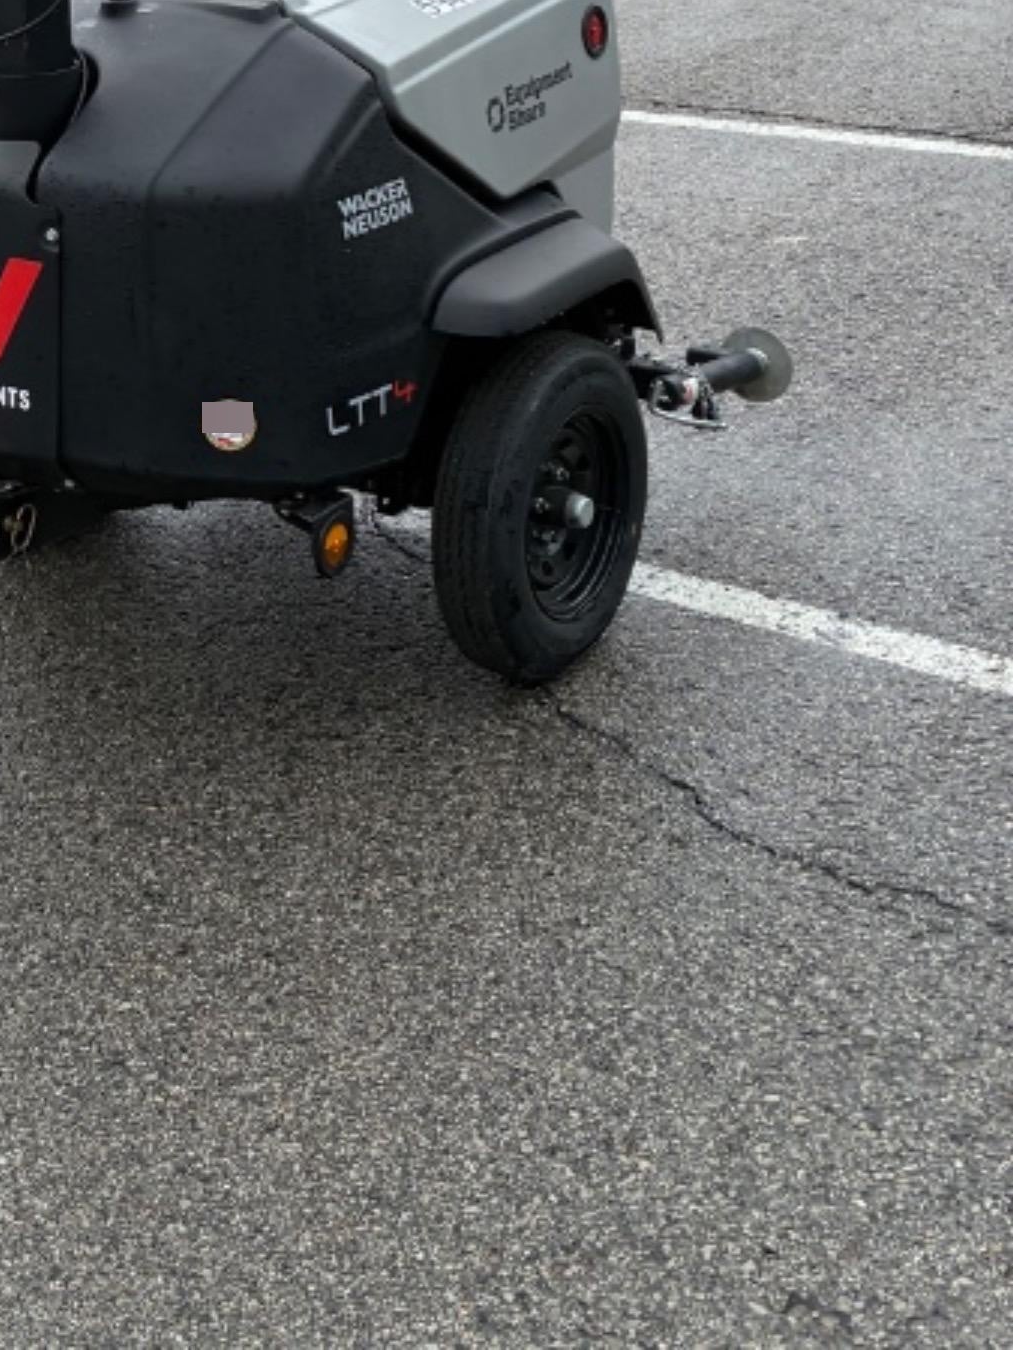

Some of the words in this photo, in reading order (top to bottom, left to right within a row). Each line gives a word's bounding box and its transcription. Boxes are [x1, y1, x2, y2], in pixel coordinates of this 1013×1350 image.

[505, 59, 573, 107] Equipment
[508, 101, 546, 131] Share
[337, 176, 408, 217] WACKER
[342, 196, 414, 241] NEUSON
